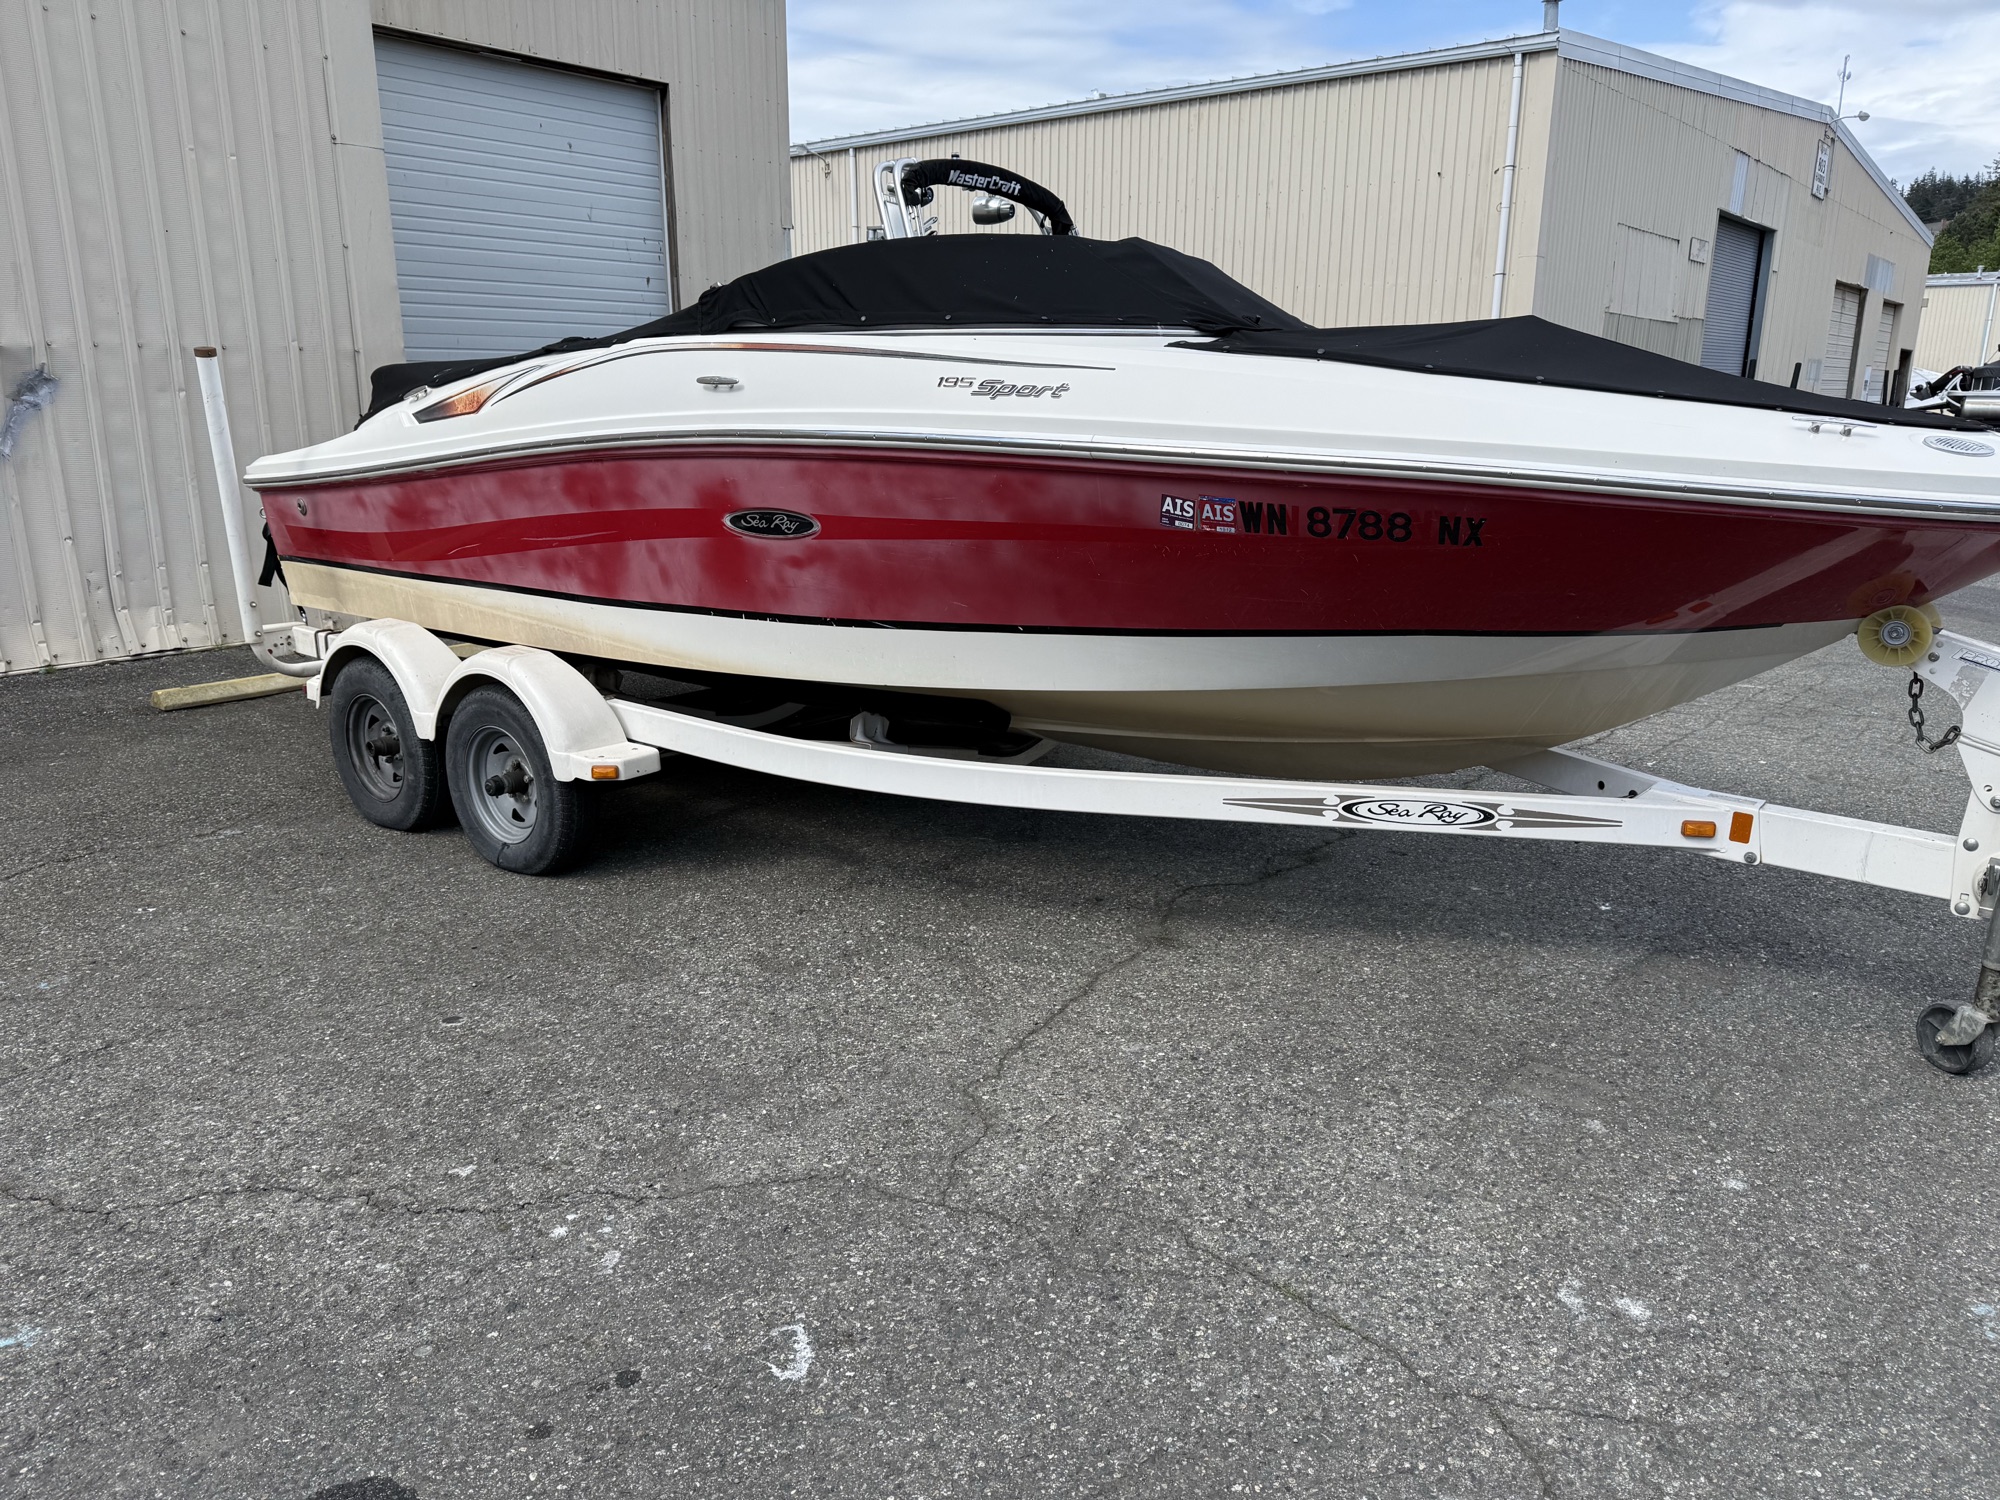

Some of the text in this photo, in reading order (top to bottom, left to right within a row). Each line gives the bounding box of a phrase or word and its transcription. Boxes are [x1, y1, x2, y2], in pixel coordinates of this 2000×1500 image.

[948, 169, 1021, 196] MasterCraft
[936, 376, 1070, 400] 195 Sport
[1161, 496, 1194, 518] AIS
[1201, 503, 1235, 523] AIS
[741, 514, 800, 534] Sea Ray
[1239, 501, 1487, 547] WN 8788 NX
[1367, 803, 1469, 824] Sea Ray
